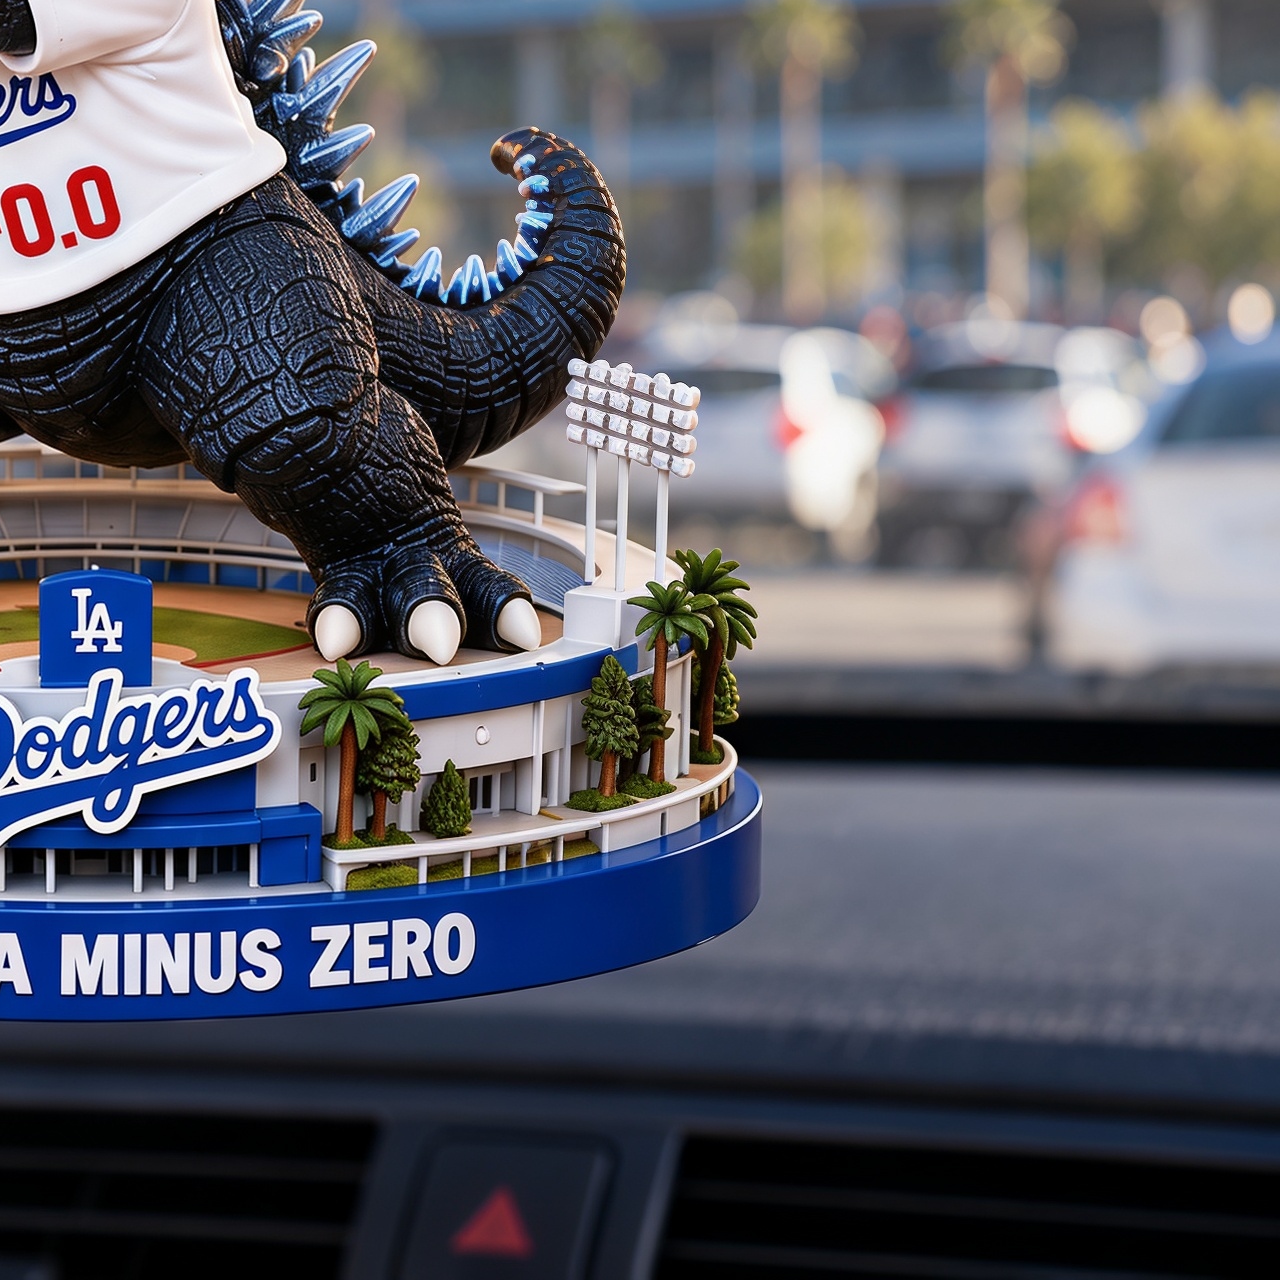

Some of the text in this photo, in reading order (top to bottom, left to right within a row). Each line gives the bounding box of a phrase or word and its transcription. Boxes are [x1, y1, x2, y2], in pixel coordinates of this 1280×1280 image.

[70, 588, 123, 653] LA
[59, 927, 283, 996] MINUS
[308, 912, 477, 989] ZERO
